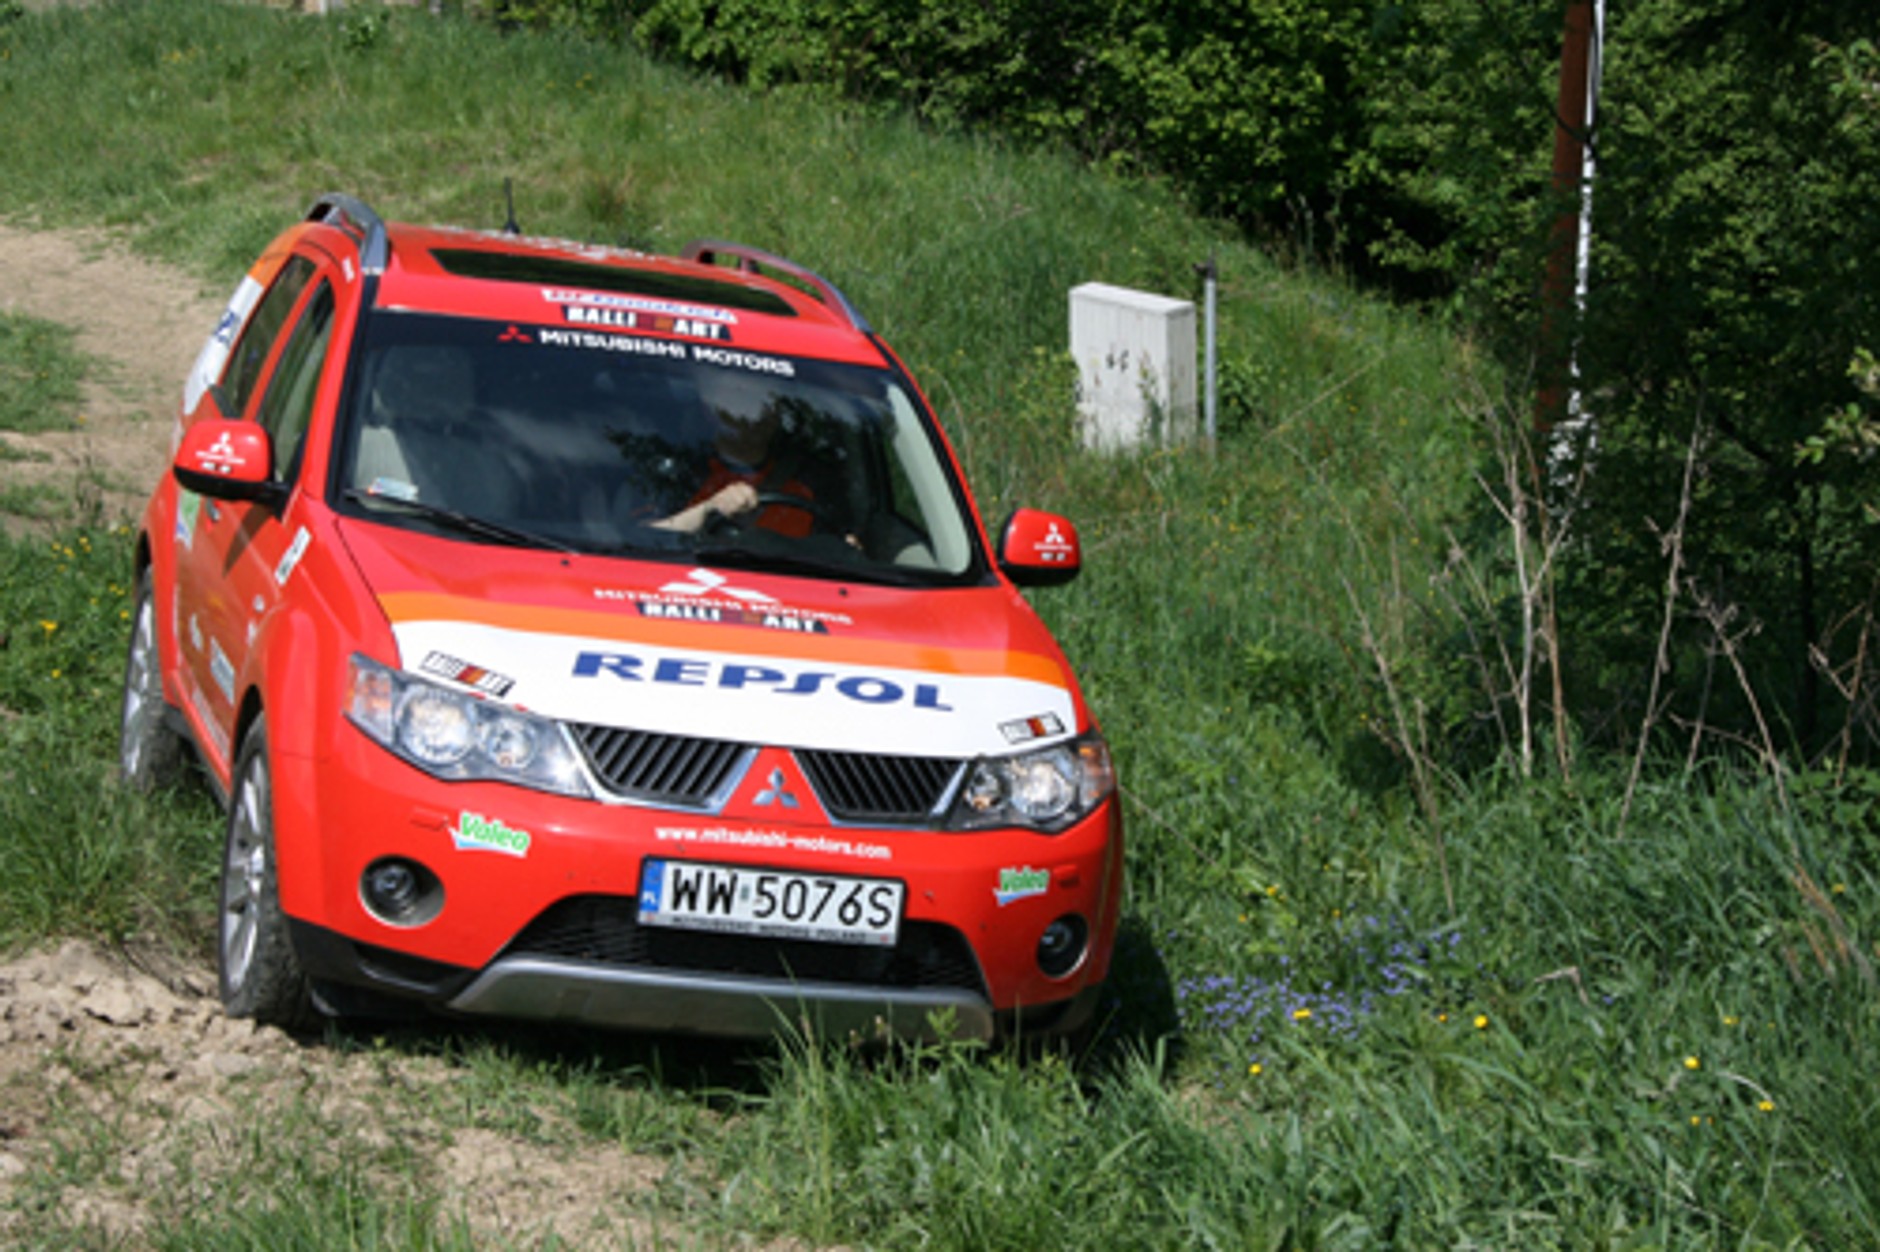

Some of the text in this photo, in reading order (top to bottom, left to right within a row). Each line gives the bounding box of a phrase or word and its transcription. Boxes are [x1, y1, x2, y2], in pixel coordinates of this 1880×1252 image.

[538, 329, 795, 377] MITSUBISHI MOTORS
[571, 651, 954, 712] REPSOL
[461, 812, 529, 851] Valeo
[655, 826, 893, 860] www.mitsubishi-motors.com
[671, 868, 739, 915] WW
[753, 875, 894, 929] 5076S
